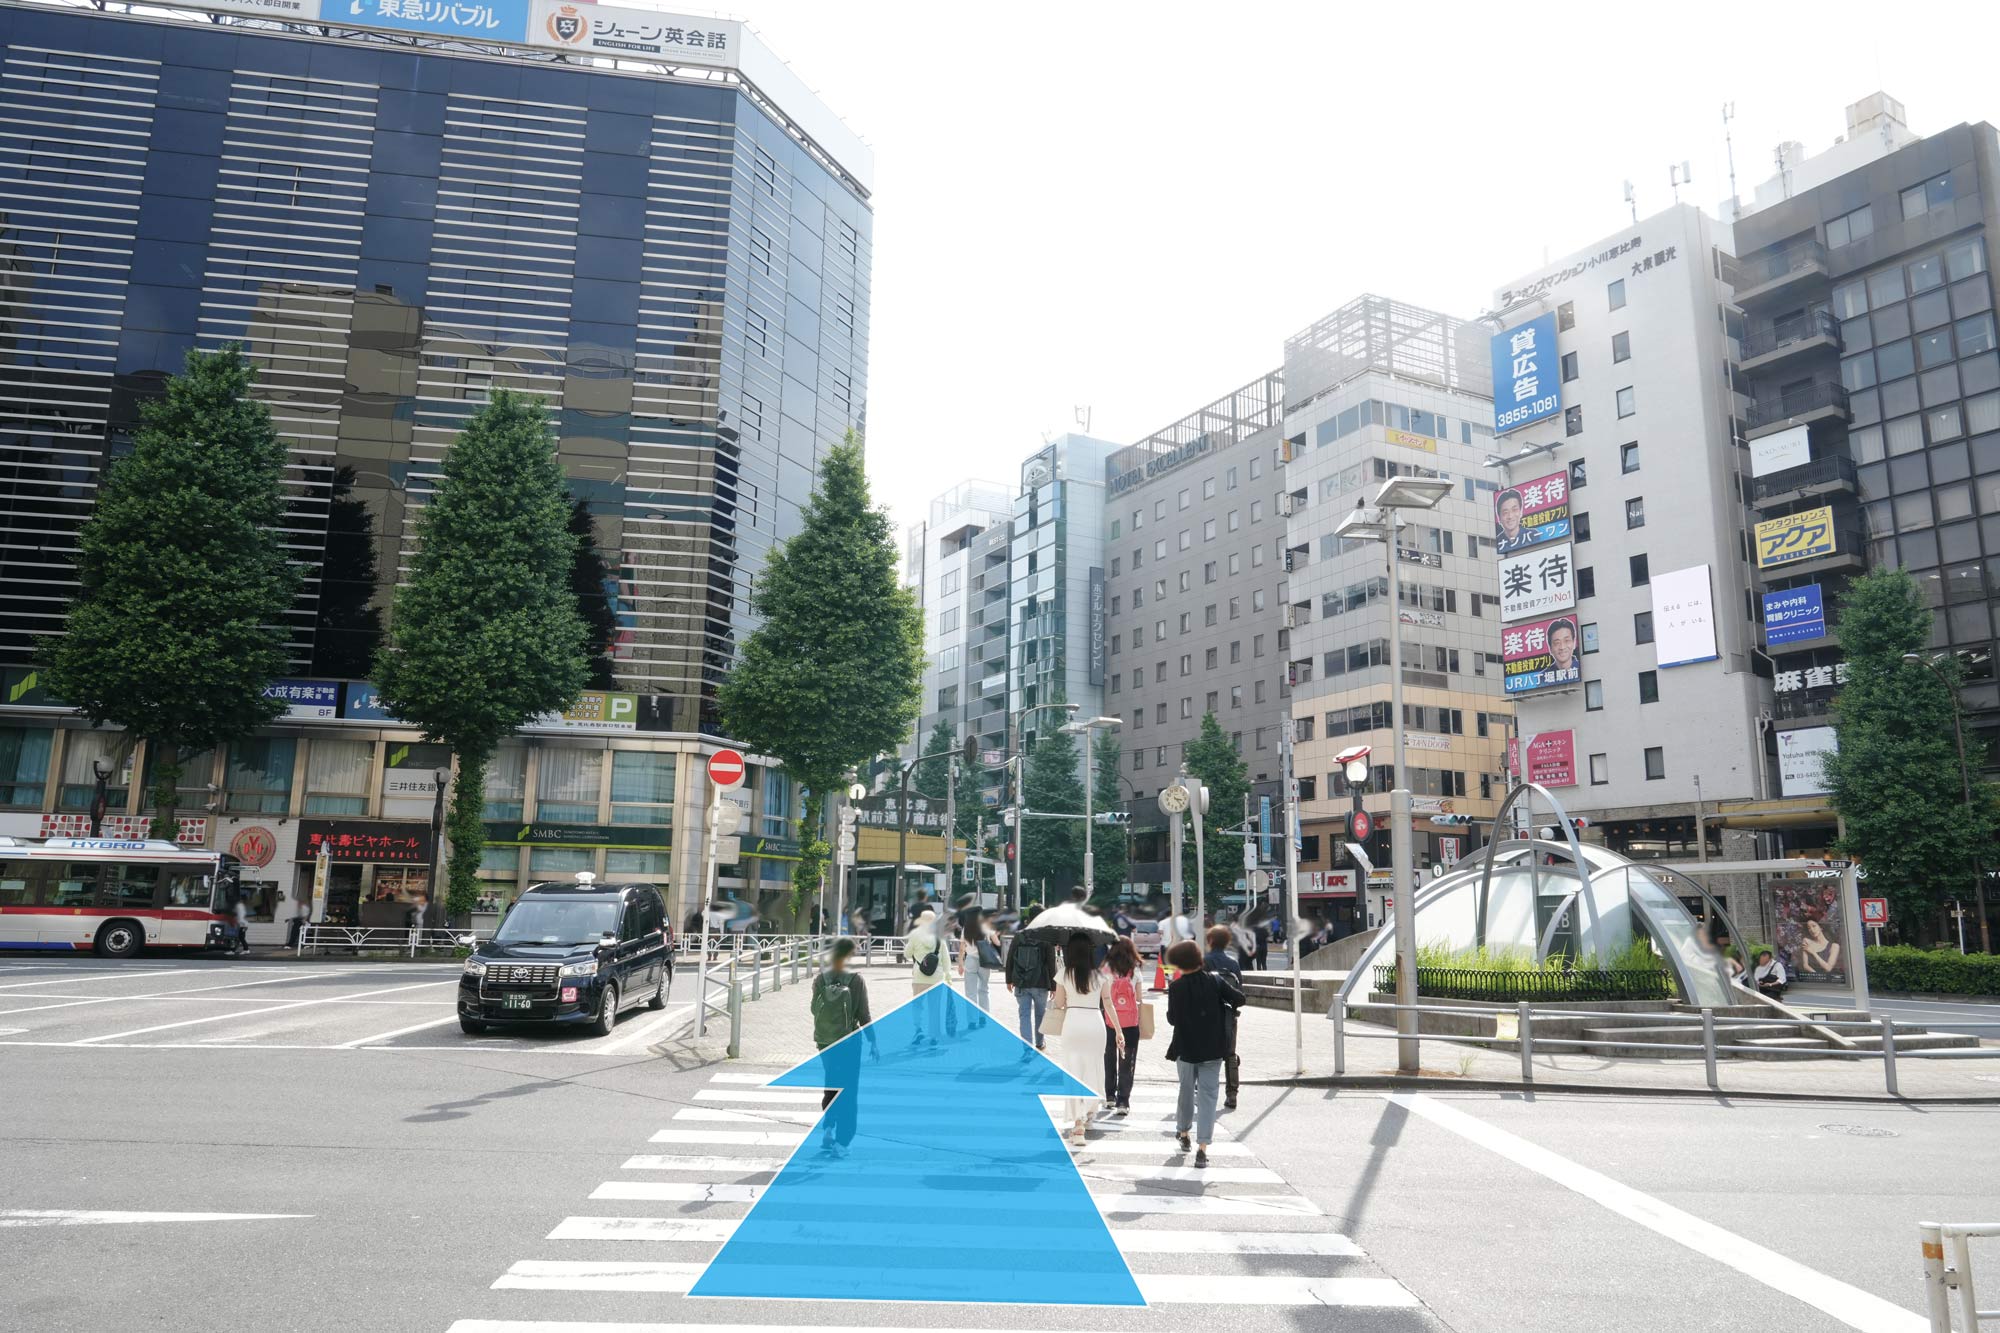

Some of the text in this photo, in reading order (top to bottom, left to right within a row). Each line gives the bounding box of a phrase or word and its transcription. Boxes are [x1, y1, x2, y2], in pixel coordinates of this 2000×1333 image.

[376, 0, 500, 29] 東急リバブル
[593, 20, 727, 50] シェーン英会話
[1510, 328, 1539, 402] 貸広告
[1498, 395, 1558, 427] 3855-1081
[1146, 432, 1209, 479] EXCELLENT
[1523, 478, 1566, 509] 楽待
[1521, 505, 1568, 528] 不動産投資アプリ
[1760, 508, 1827, 533] コンタクトレンズ
[1498, 523, 1568, 551] ナンバーワン
[1760, 523, 1827, 555] アクア
[1777, 549, 1816, 561] VISION
[1503, 553, 1568, 599] 楽待
[1766, 596, 1807, 611] まみや内科
[1766, 606, 1821, 623] 胃腸クリニック
[1092, 583, 1104, 670] ホテルエクセレント
[1504, 627, 1545, 656] 楽待
[1505, 656, 1552, 675] 不動産投資アプリ
[1506, 667, 1579, 690] JR八丁堀駅前
[611, 698, 632, 719] P
[389, 782, 437, 792] 三井住友銀
[71, 841, 146, 850] HYBRID
[533, 829, 562, 838] SMBC
[1327, 875, 1348, 887] KFC
